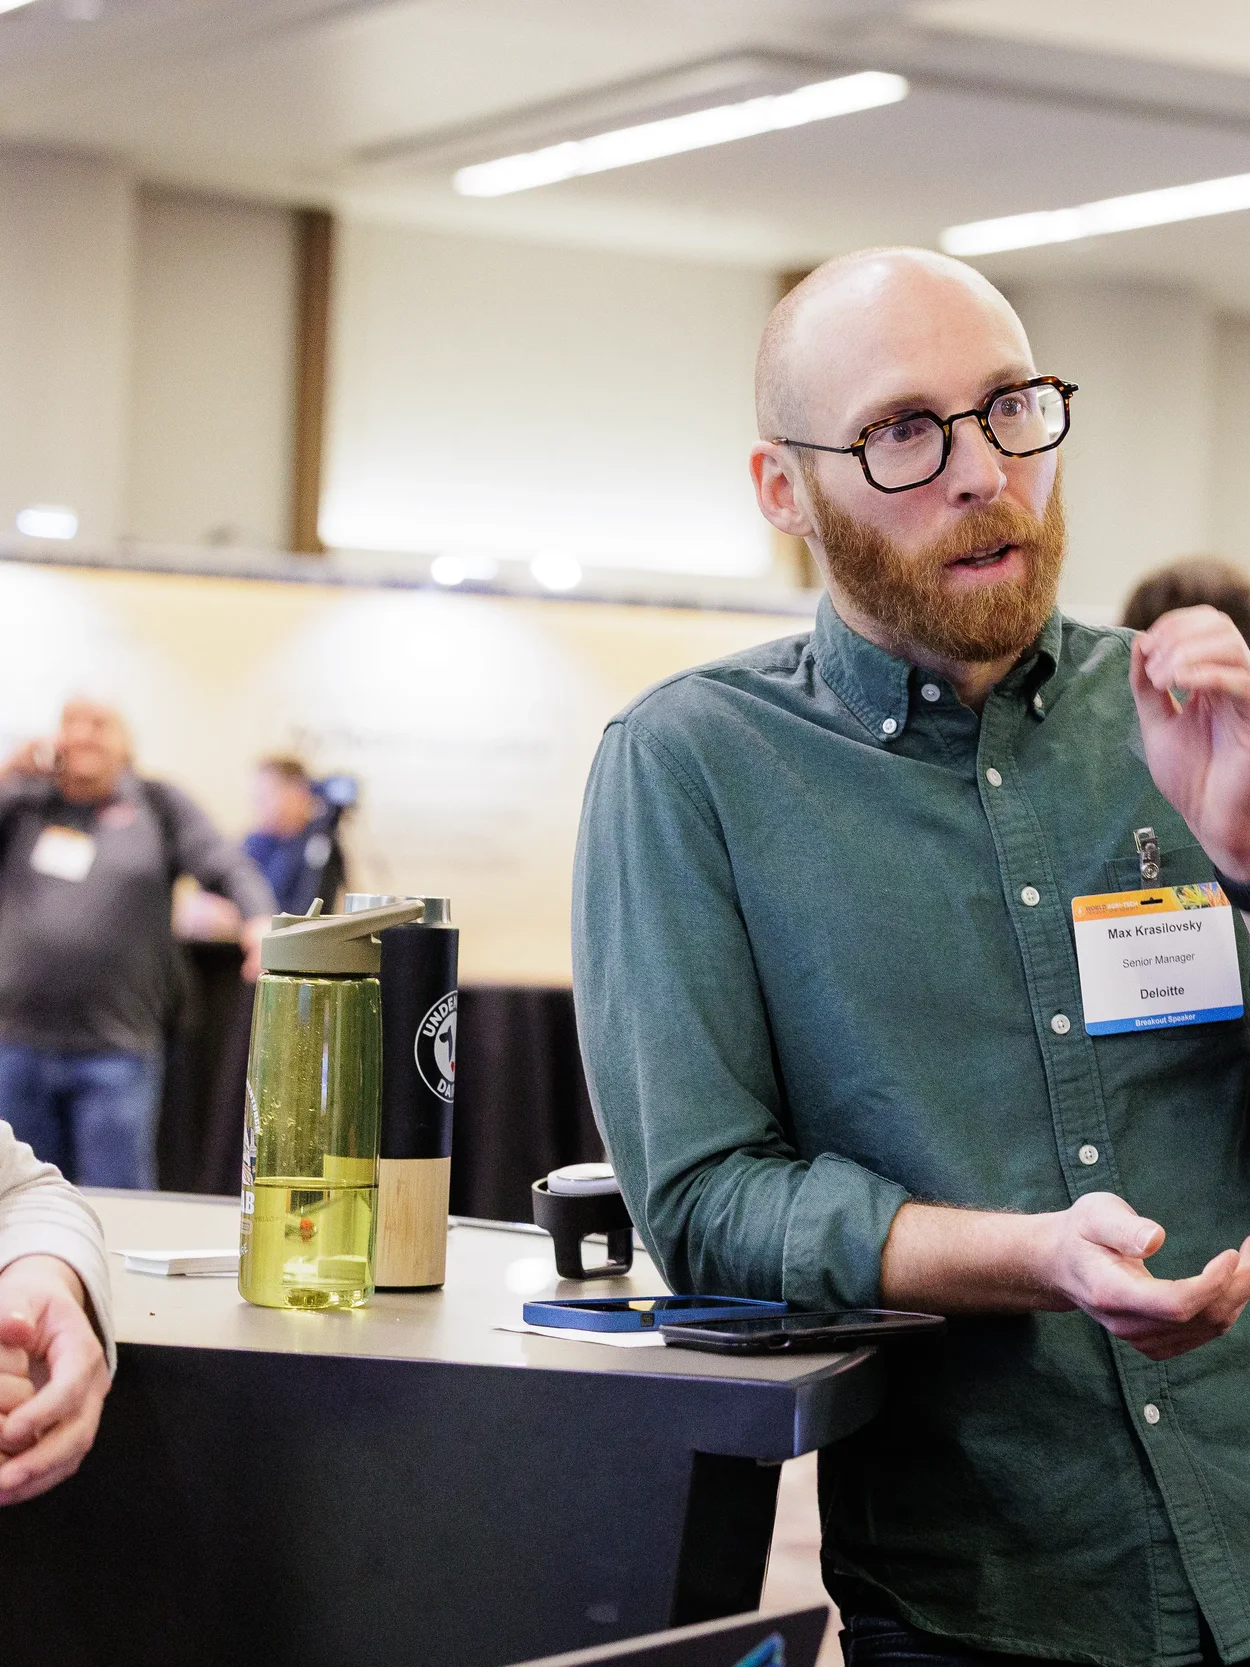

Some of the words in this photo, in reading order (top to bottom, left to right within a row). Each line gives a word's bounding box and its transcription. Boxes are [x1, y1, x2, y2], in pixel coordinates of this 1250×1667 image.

[1108, 928, 1132, 939] Max
[1135, 920, 1202, 936] Krasilovsky
[1122, 957, 1152, 969] Senior
[1155, 953, 1195, 965] Manager
[1140, 986, 1185, 999] Deloitte
[1135, 1016, 1167, 1027] Breakout
[1168, 1013, 1196, 1024] Speaker
